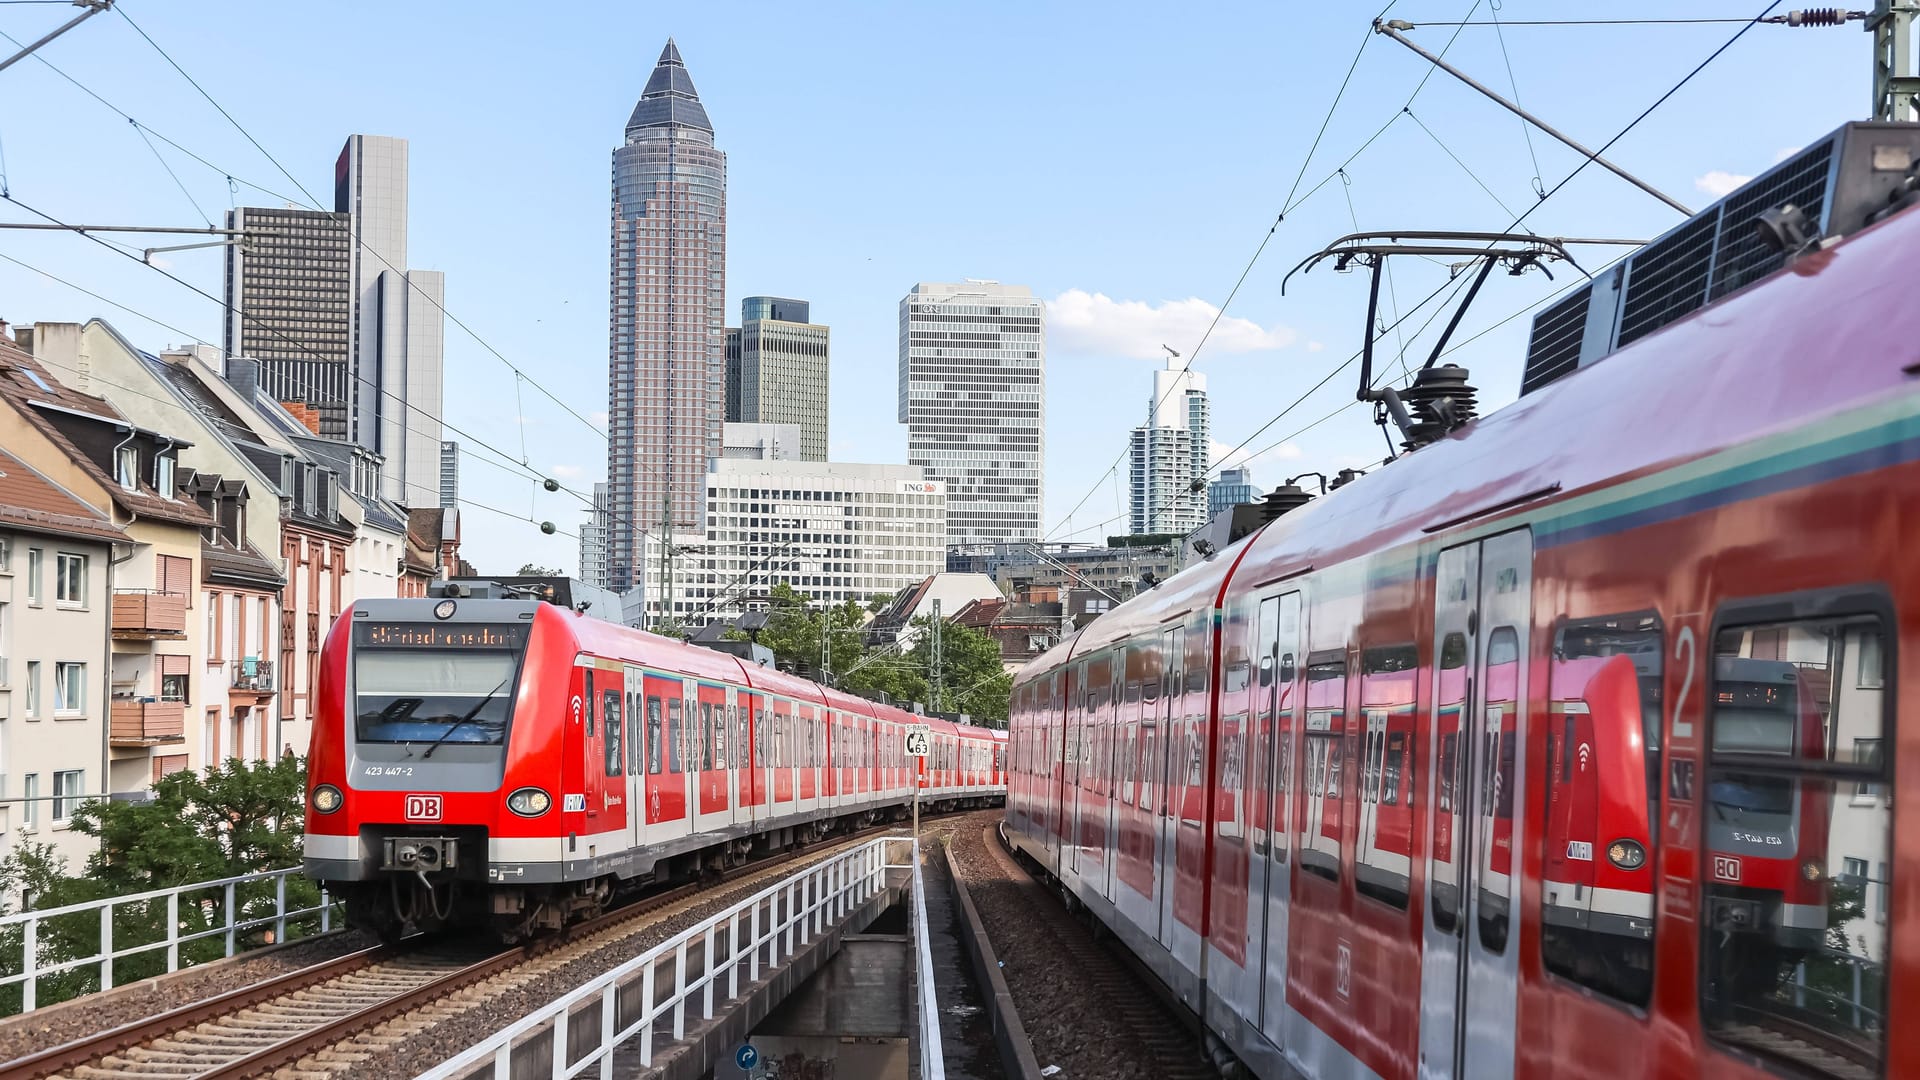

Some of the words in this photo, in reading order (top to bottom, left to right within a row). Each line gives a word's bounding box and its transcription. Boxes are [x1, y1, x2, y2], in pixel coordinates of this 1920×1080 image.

[904, 483, 923, 492] ING
[1672, 626, 1695, 737] 2
[917, 734, 925, 743] A
[915, 744, 928, 754] 63
[365, 766, 383, 777] 423
[385, 766, 413, 777] 447-2
[410, 799, 439, 817] DB
